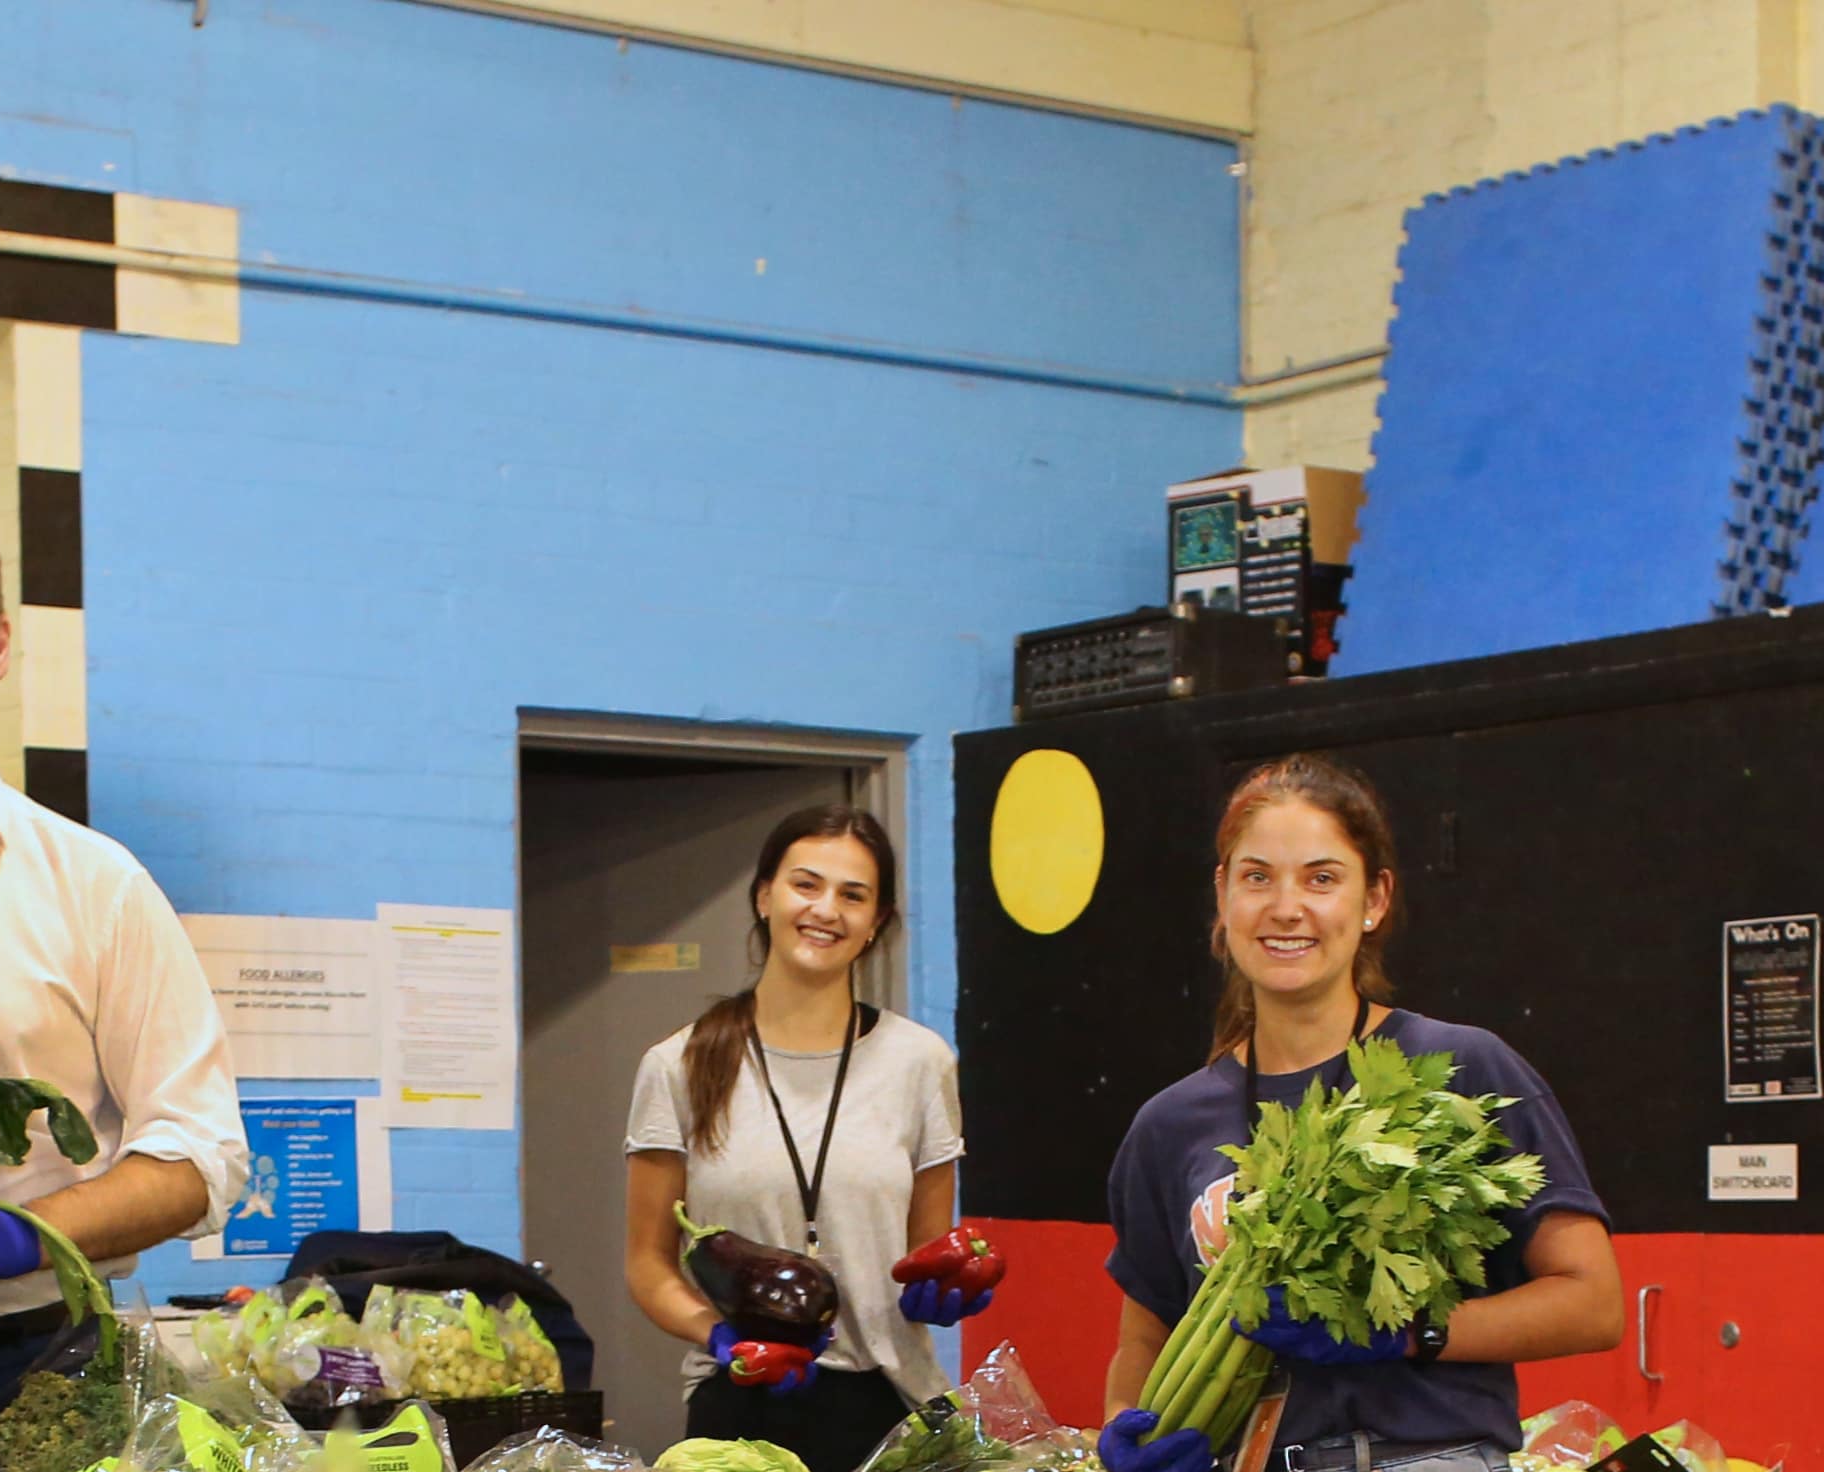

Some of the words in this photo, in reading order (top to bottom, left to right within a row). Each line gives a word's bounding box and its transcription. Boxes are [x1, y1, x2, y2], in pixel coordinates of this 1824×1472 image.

[1731, 924, 1779, 943] What's
[1785, 922, 1809, 940] On
[239, 968, 269, 981] FOOD
[273, 970, 325, 983] ALLERGIES
[1738, 1156, 1766, 1169] MAIN
[1713, 1176, 1794, 1190] SWITCHBOARD
